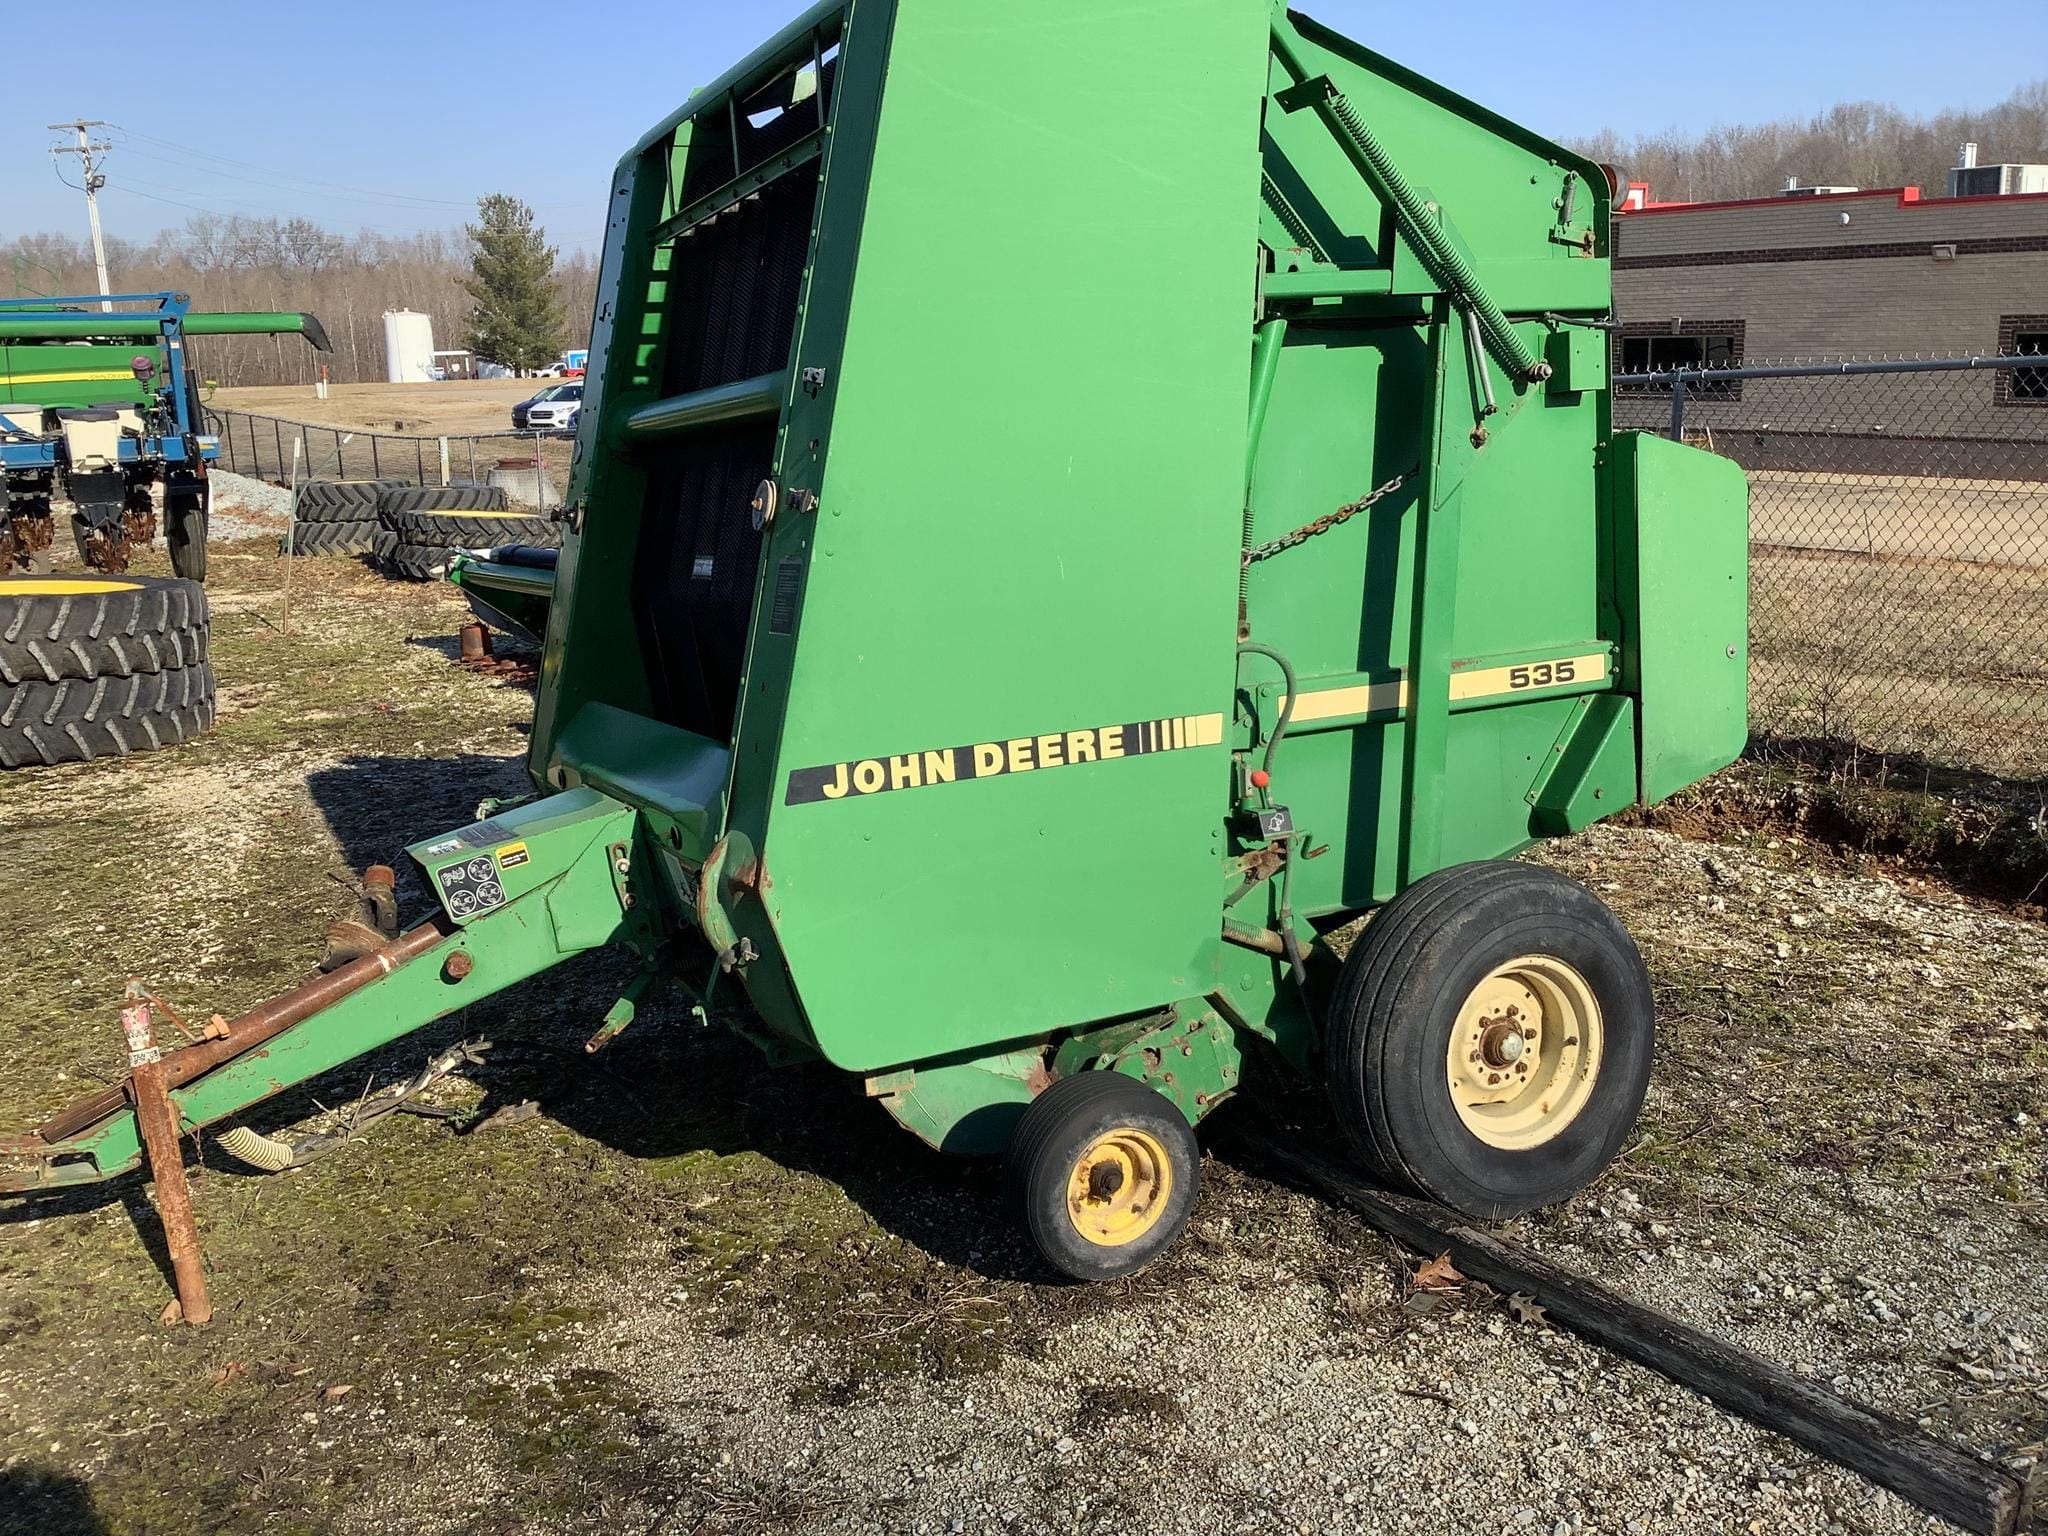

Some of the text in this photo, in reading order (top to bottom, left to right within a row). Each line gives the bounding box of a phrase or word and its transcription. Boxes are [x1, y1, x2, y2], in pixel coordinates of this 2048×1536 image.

[1509, 660, 1575, 689] 535
[822, 724, 1126, 799] JOHN DEERE
